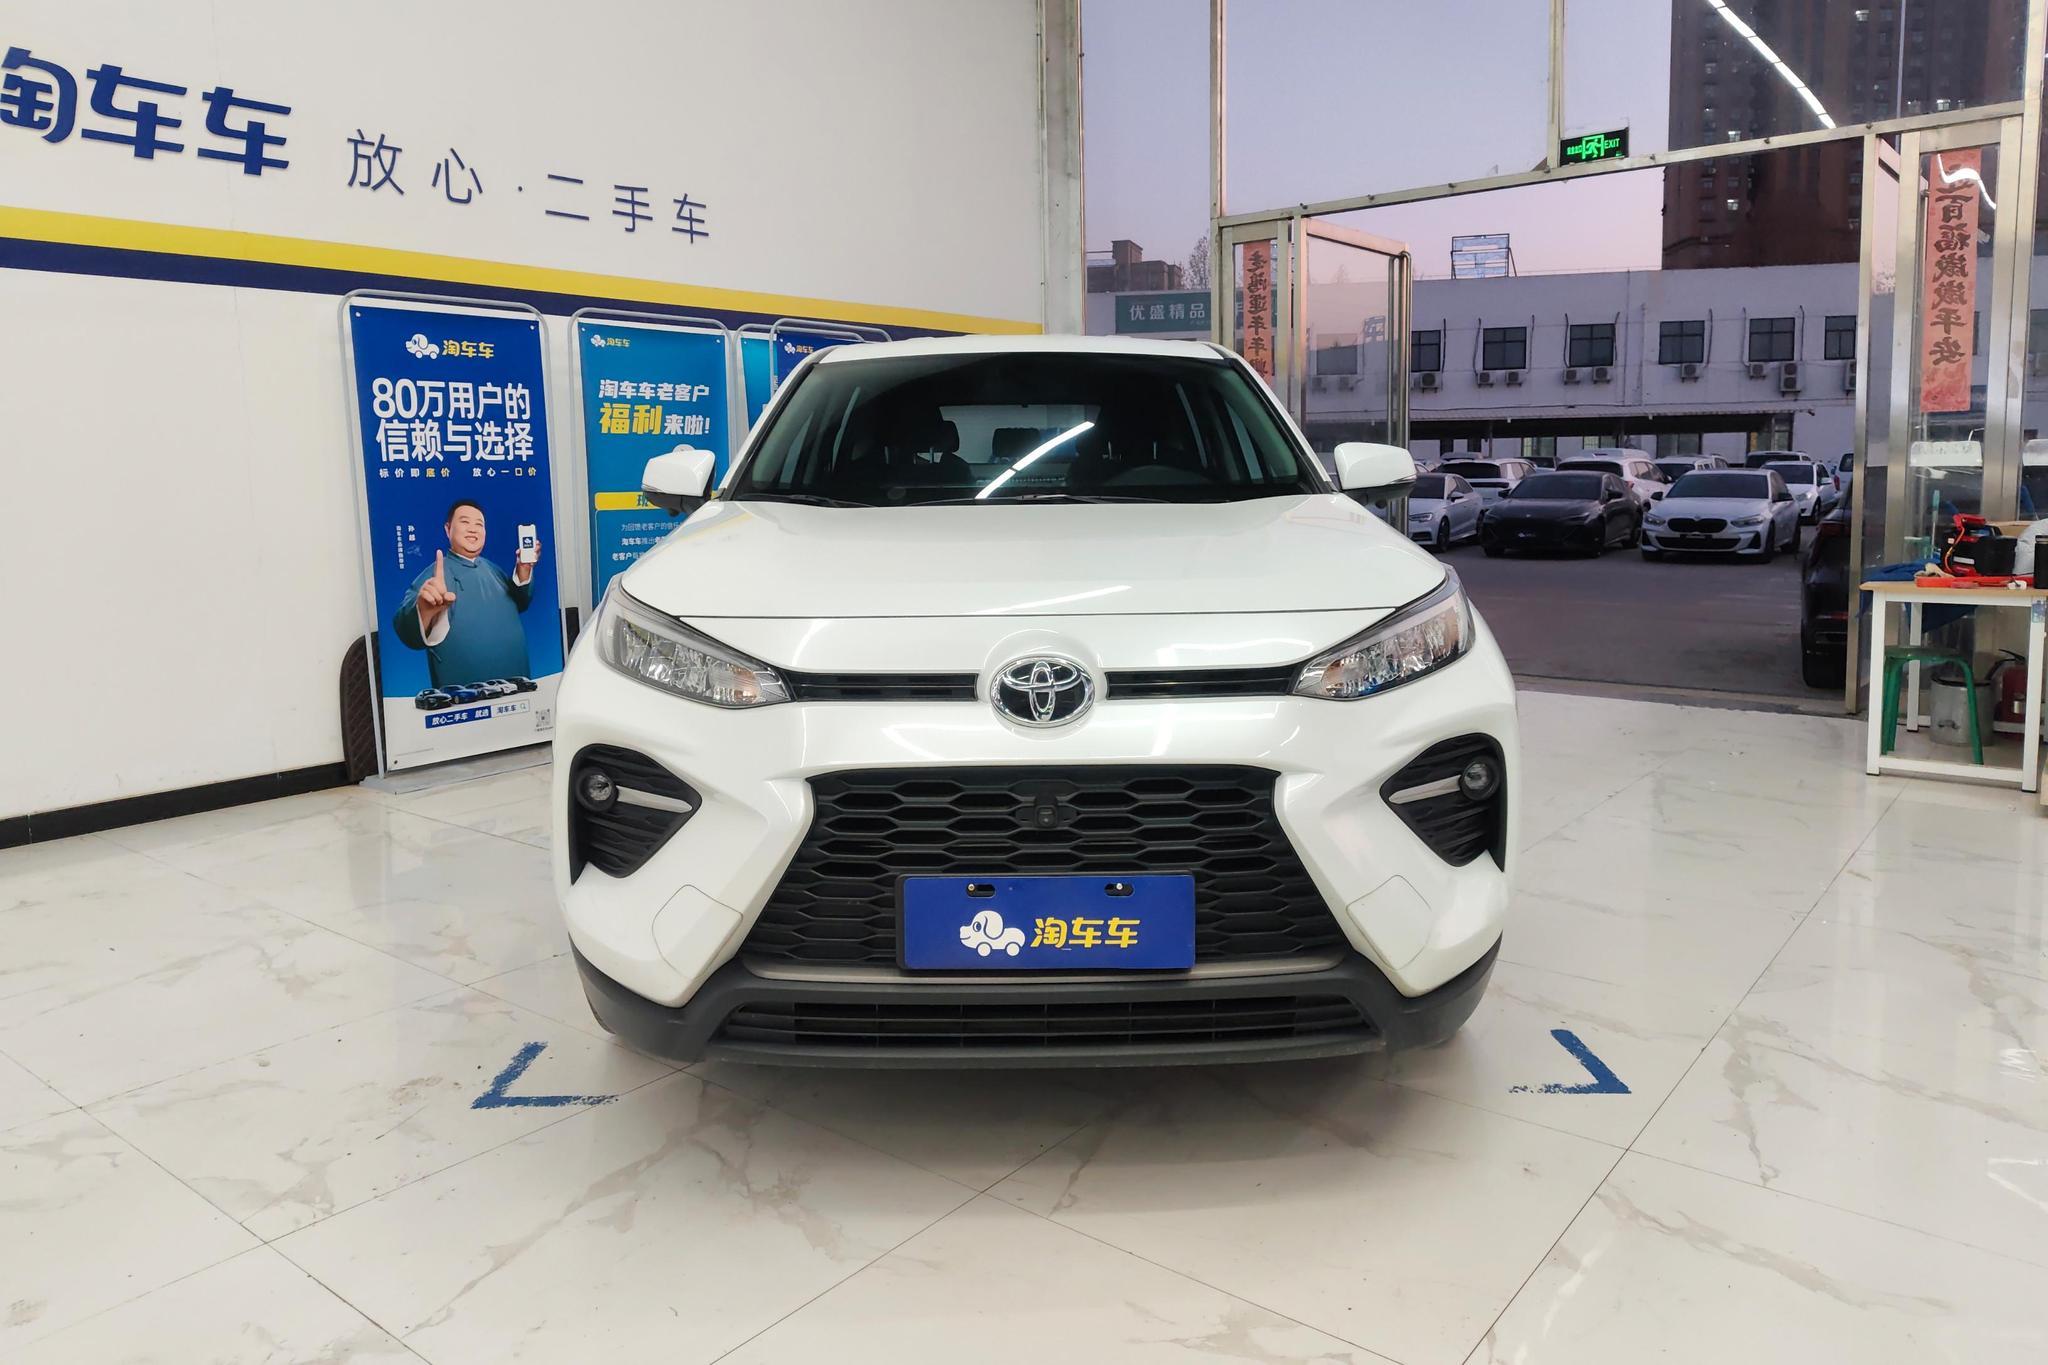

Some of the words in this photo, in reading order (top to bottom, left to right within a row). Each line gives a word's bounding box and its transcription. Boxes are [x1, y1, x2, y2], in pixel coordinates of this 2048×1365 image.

[1604, 138, 1620, 149] EXIT
[1129, 302, 1205, 321] 优盛精品
[442, 339, 495, 359] 淘车车
[606, 337, 631, 348] 淘车车
[372, 377, 532, 420] 80万用户的
[598, 379, 710, 402] 淘车车老客户
[376, 419, 534, 462] 信赖与选择
[379, 467, 451, 478] 标价即底价
[472, 467, 537, 477] 放心一口价
[432, 712, 468, 726] 放心二手车
[1030, 917, 1140, 949] 淘车车
